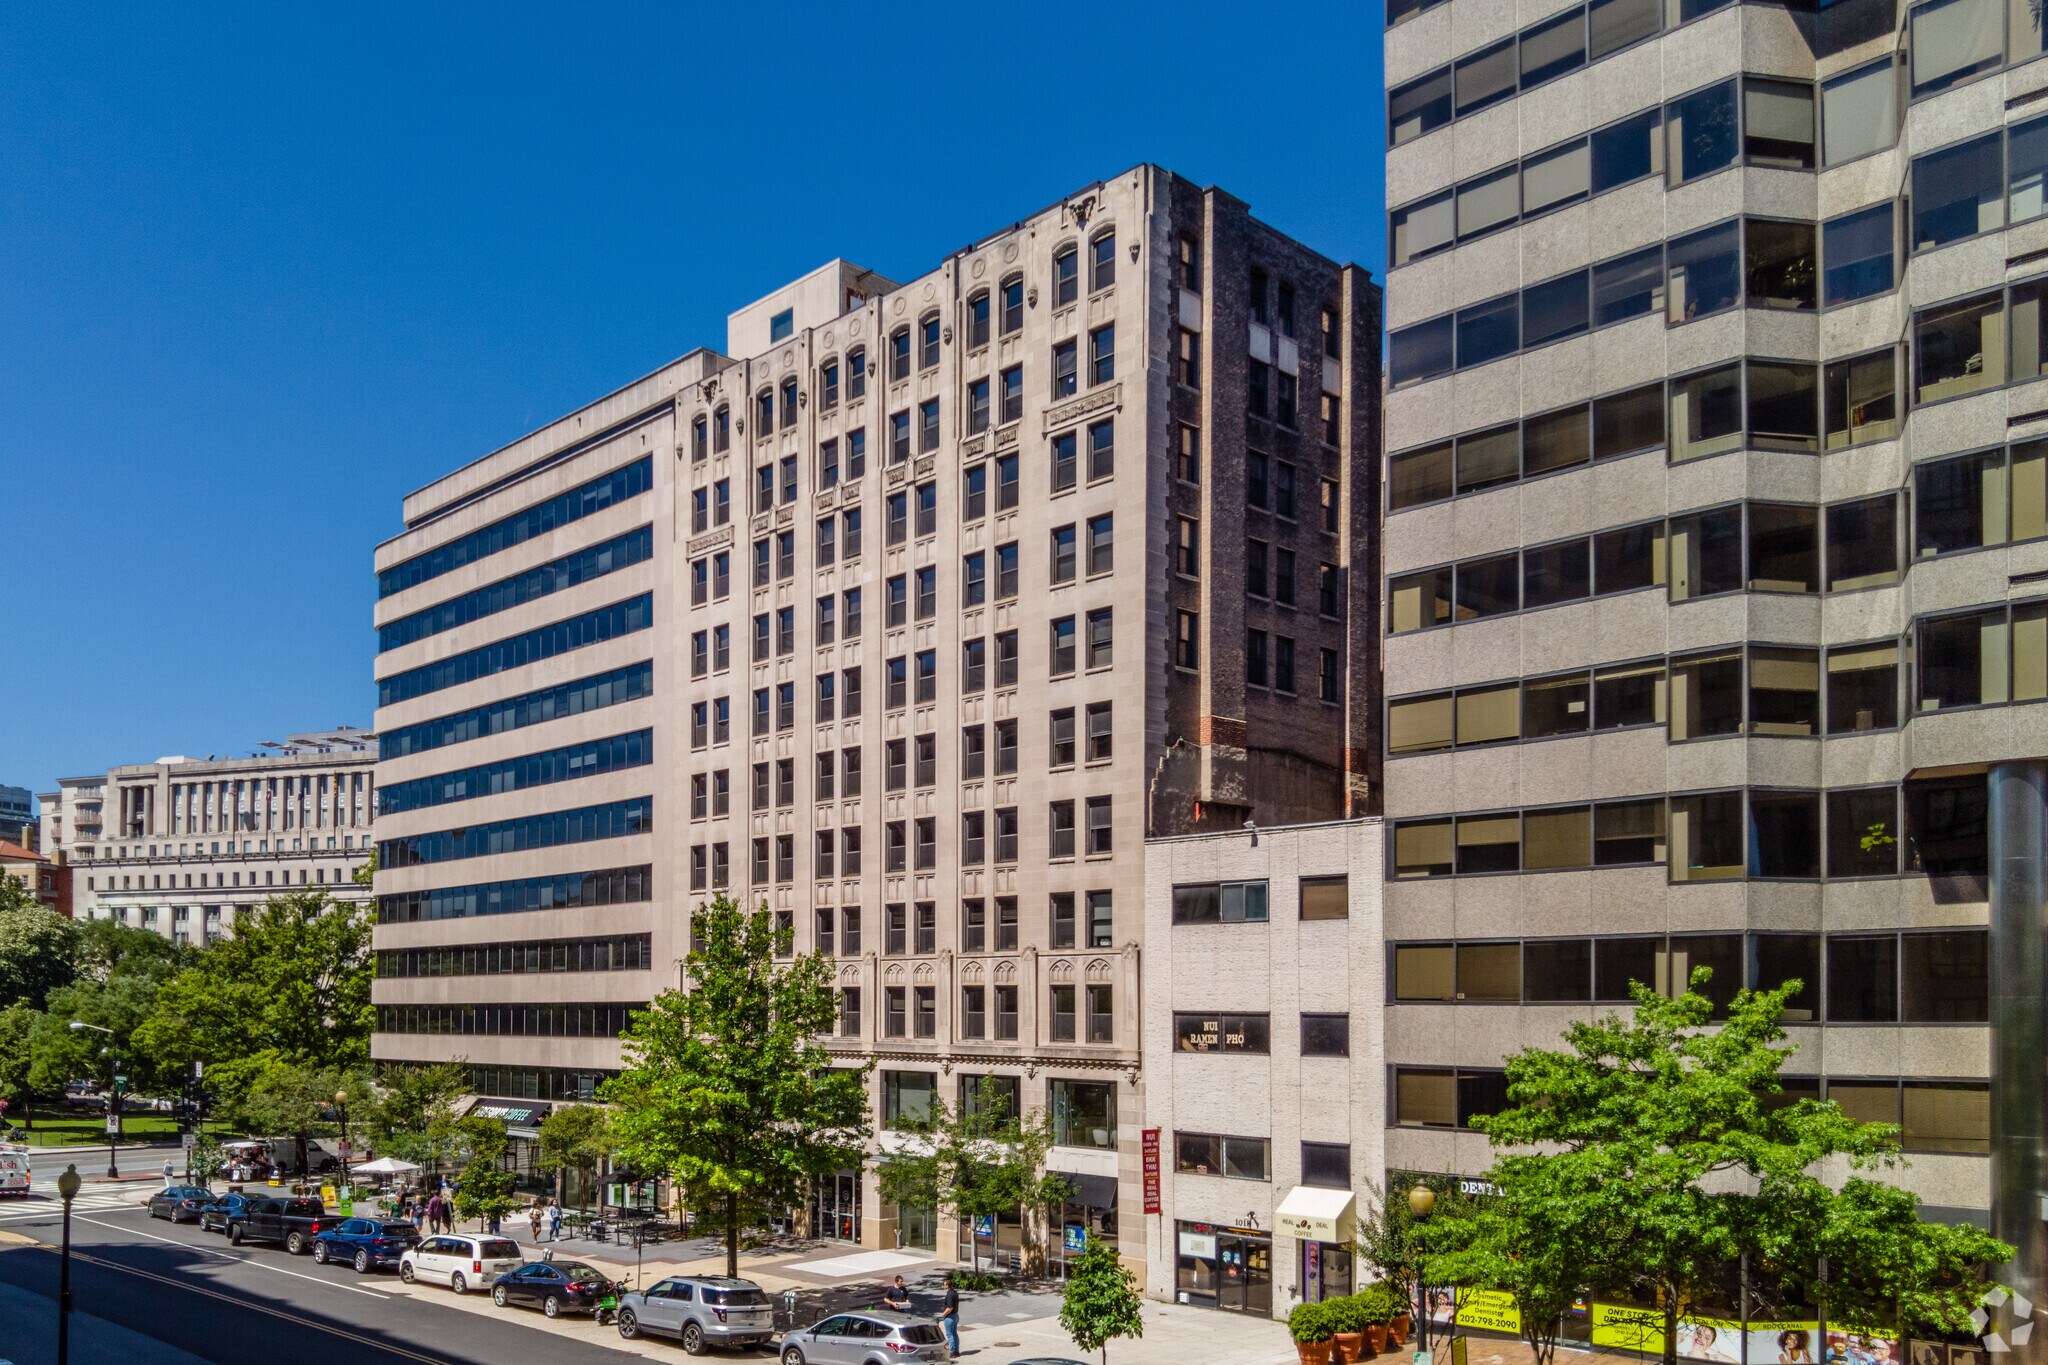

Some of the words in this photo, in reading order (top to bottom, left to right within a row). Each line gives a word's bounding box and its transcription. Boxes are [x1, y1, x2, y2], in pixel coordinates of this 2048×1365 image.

[1203, 1021, 1218, 1031] NUI
[1190, 1034, 1218, 1044] RAMEN
[1282, 1218, 1294, 1226] REAL
[1294, 1230, 1312, 1238] COFFEE
[1473, 1292, 1503, 1301] Cosmetic
[1607, 1308, 1626, 1317] ONE
[1459, 1314, 1517, 1329] 202-798-2090
